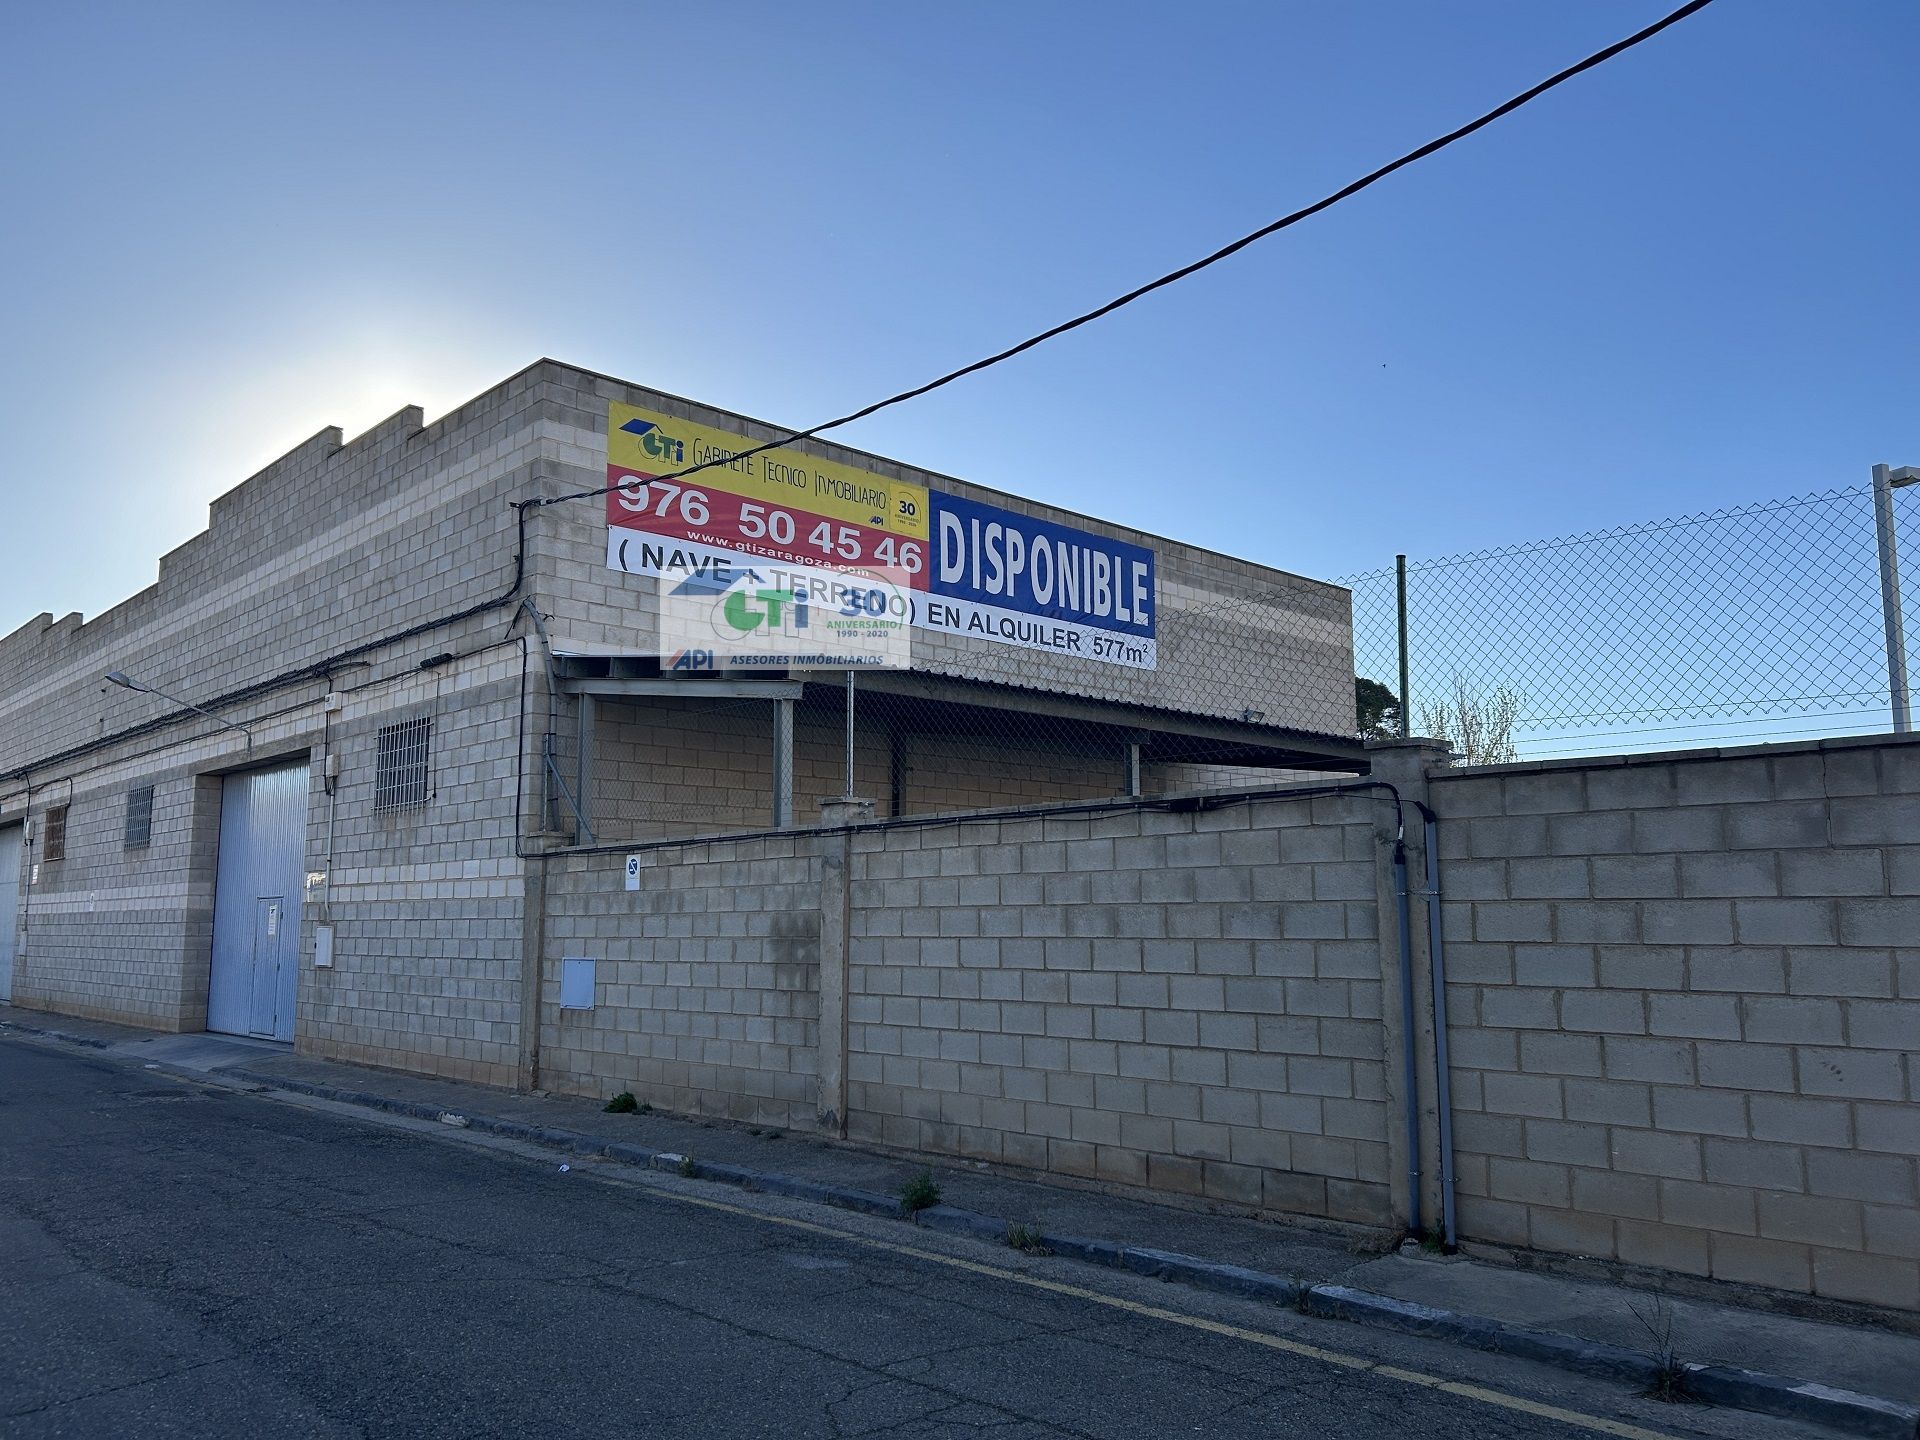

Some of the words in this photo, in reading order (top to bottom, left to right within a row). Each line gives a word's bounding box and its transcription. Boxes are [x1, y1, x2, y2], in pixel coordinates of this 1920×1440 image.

[761, 455, 807, 488] TECNICO
[815, 470, 886, 509] INMOBILIARIO
[899, 500, 916, 516] 30
[618, 475, 710, 526] 976
[738, 502, 796, 545] 50
[808, 522, 862, 560] 45
[873, 537, 923, 574] 46
[868, 515, 884, 526] API
[687, 531, 870, 577] www.gtizaragoza.com
[938, 509, 1149, 627] DISPONIBLE
[641, 543, 732, 583] NAVE
[928, 602, 961, 629] EN
[968, 611, 1081, 652] ALQUILER
